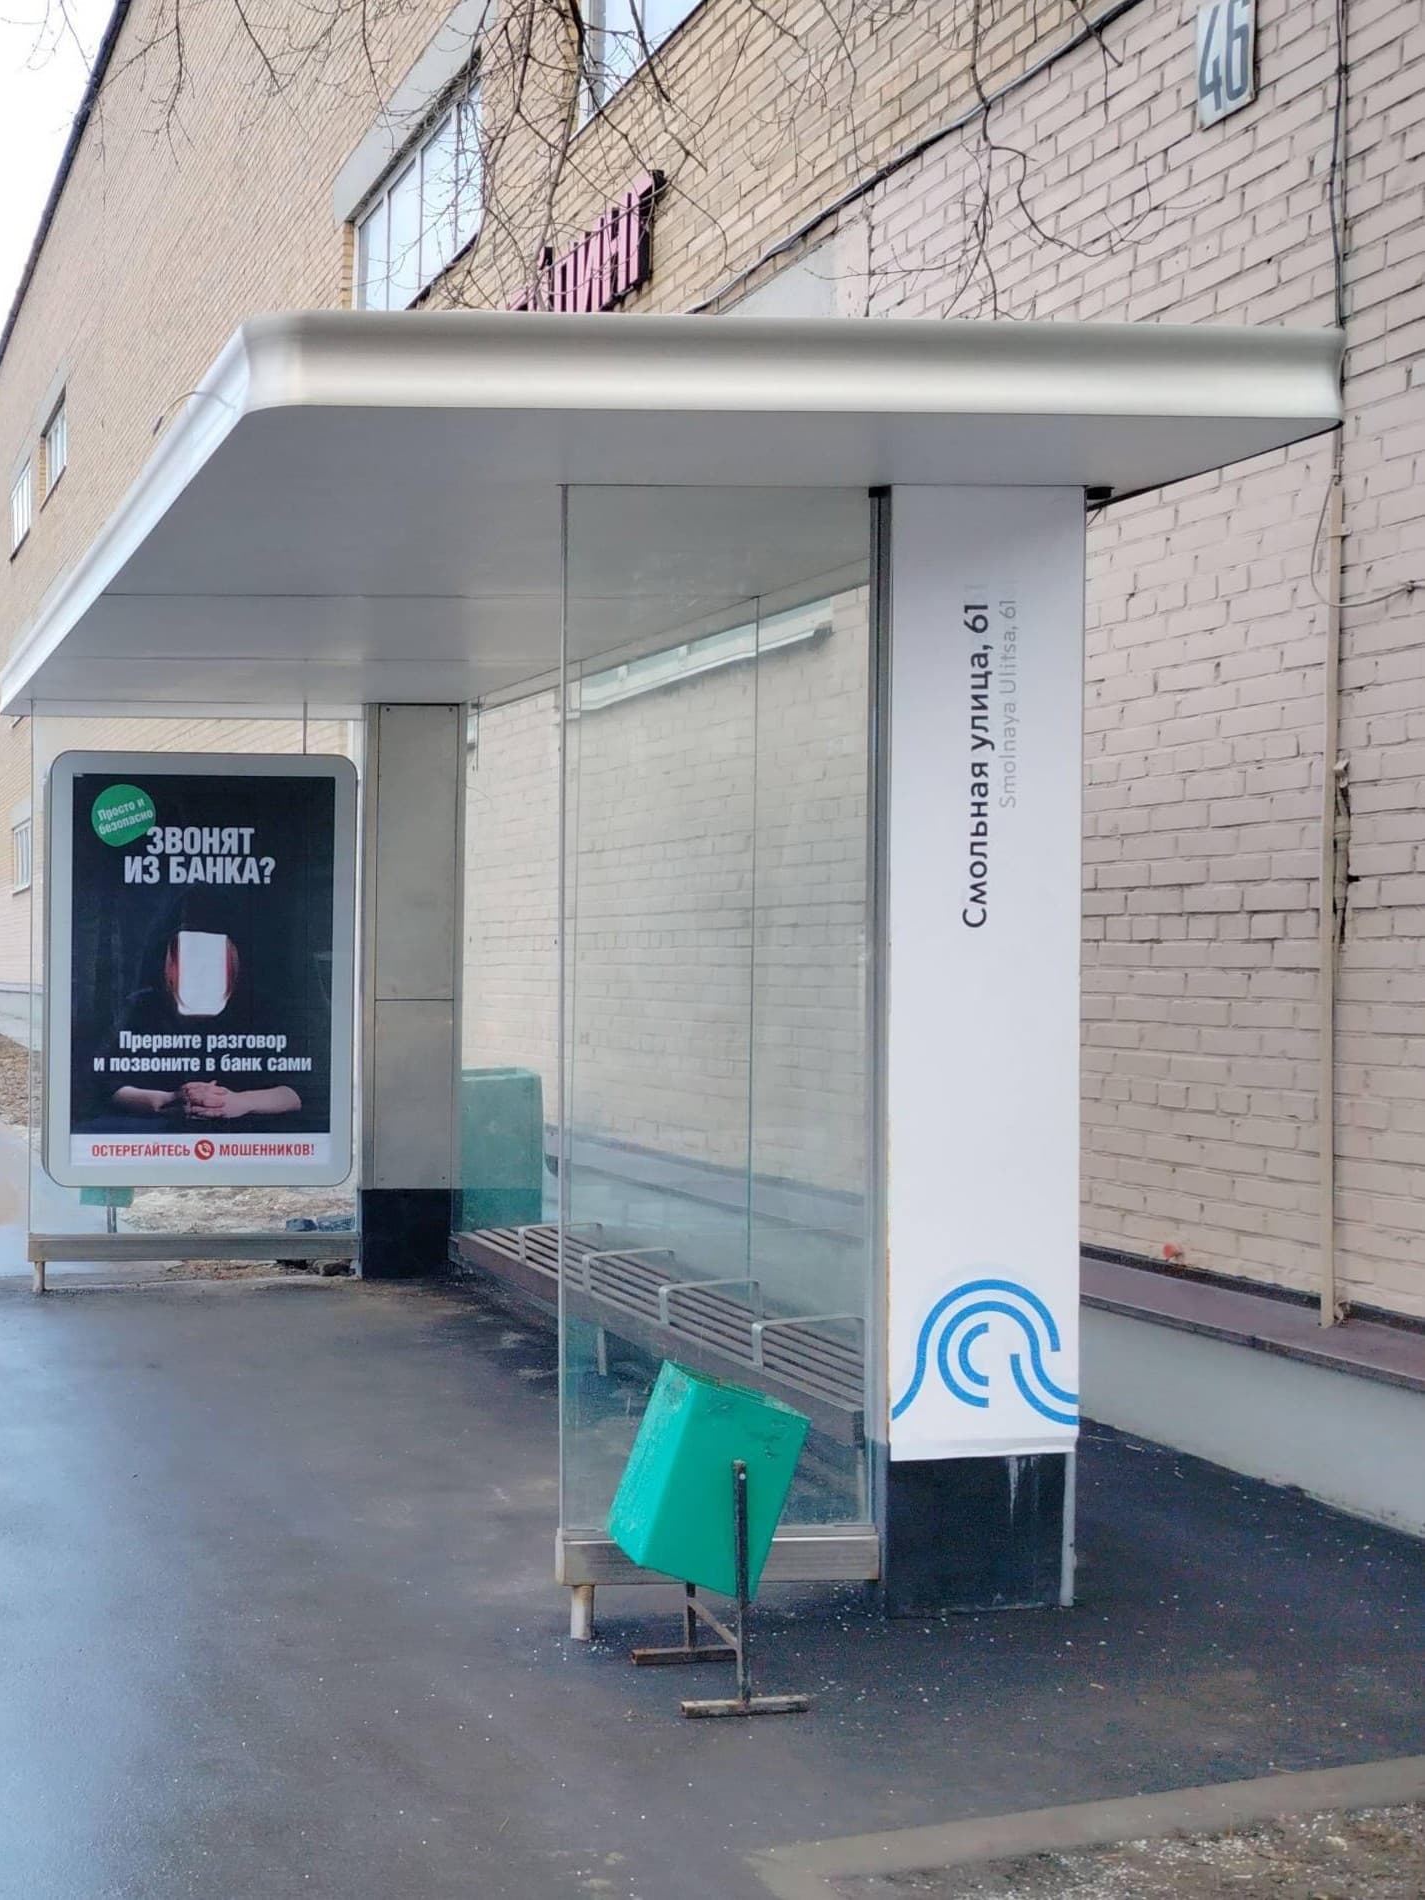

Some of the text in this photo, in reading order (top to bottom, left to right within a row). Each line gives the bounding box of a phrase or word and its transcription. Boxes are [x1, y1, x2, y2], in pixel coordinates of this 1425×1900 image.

[1198, 0, 1250, 112] 46
[998, 600, 1020, 809] Smolnaya Ulitsa, 61
[962, 604, 995, 928] Смольная улица, 61
[97, 798, 146, 821] Просто и
[98, 809, 154, 835] безопасно
[146, 826, 255, 855] ЗВОНЯТ
[124, 856, 276, 884] ИЗ БАНКА?
[119, 1031, 287, 1053] Прервите разговор
[93, 1054, 312, 1072] и позвоните в банк сами
[91, 1142, 315, 1157] ОСТЕРЕГАЙТЕСЬ МОШЕННИКОВ!
